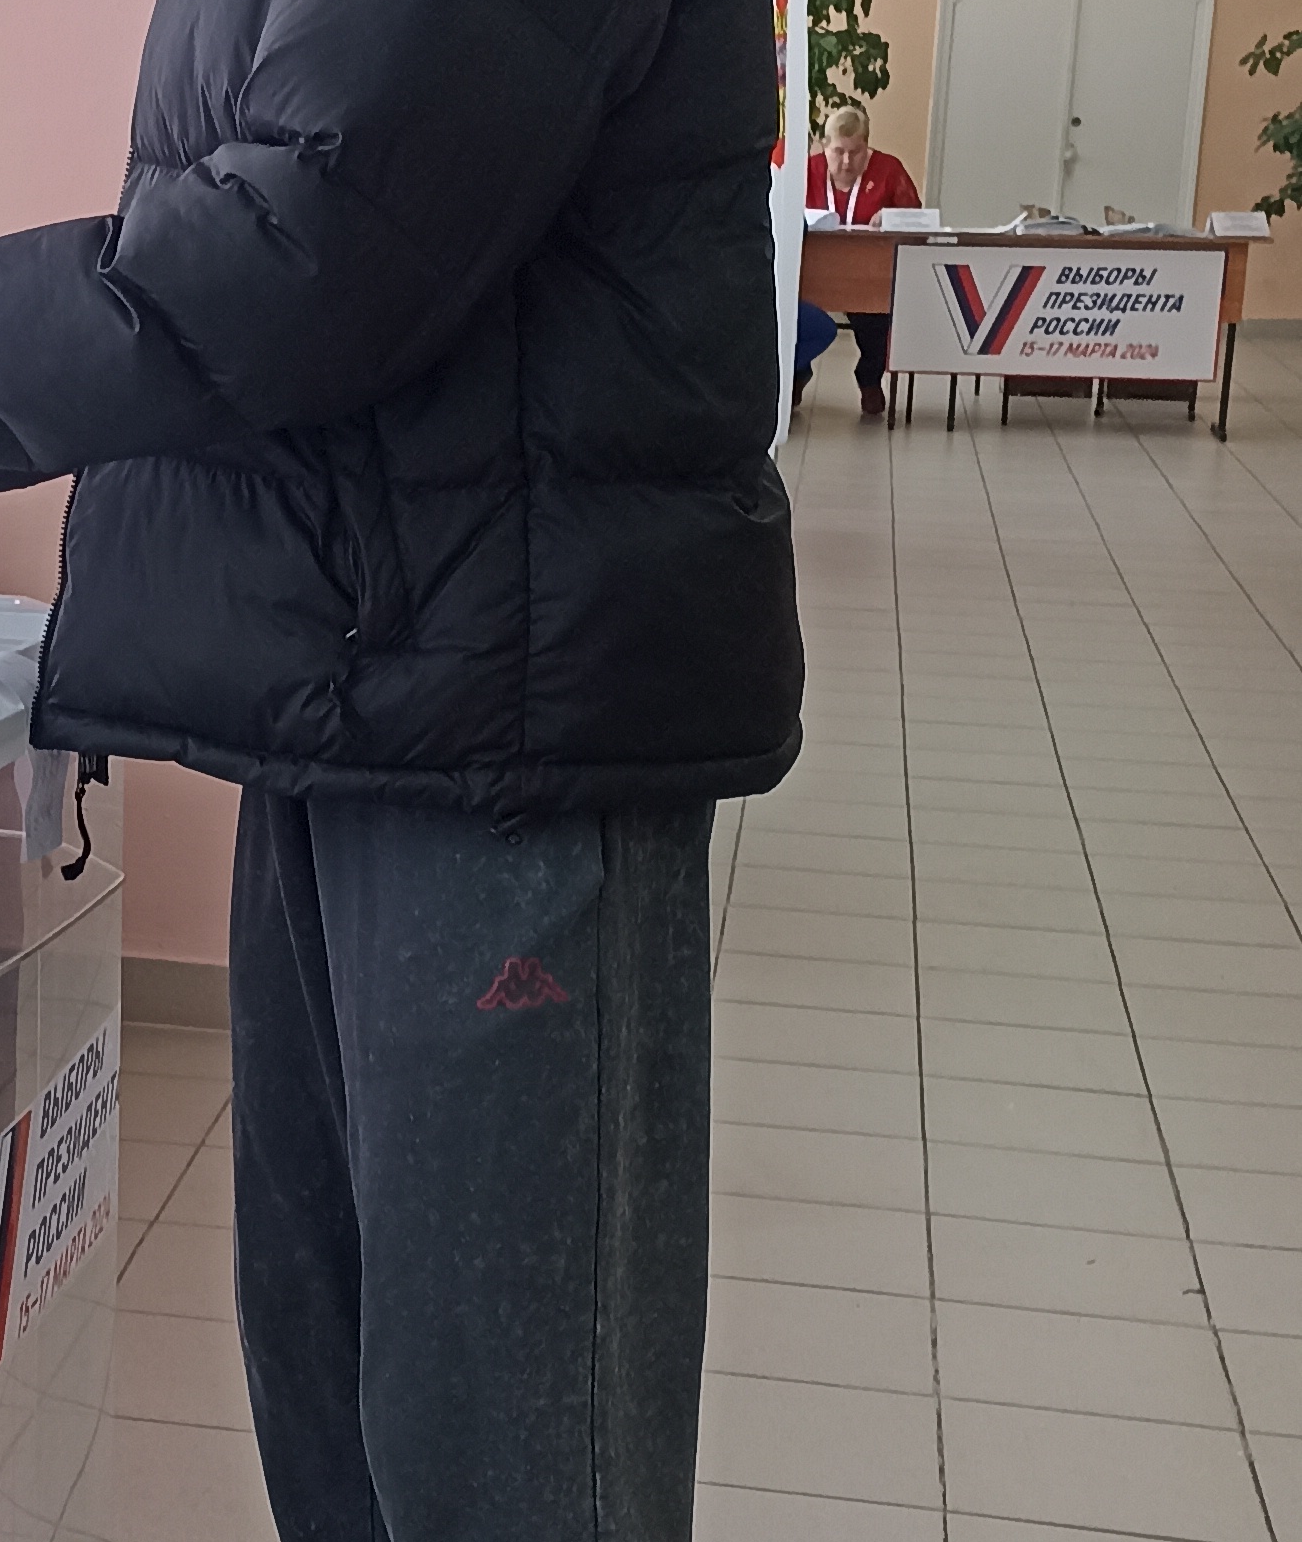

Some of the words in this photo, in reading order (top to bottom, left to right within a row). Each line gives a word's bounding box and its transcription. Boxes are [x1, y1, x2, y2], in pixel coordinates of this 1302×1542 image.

[1055, 266, 1158, 286] ВЫБОРЫ
[1042, 291, 1185, 314] ПРЕЗИДЕНТА
[1028, 316, 1121, 337] РОССИИ
[1064, 342, 1118, 358] МАРТА
[39, 1027, 107, 1140] ВЫБОРЫ
[23, 1166, 87, 1280] РОССИИ
[50, 1221, 87, 1299] МАРТА
